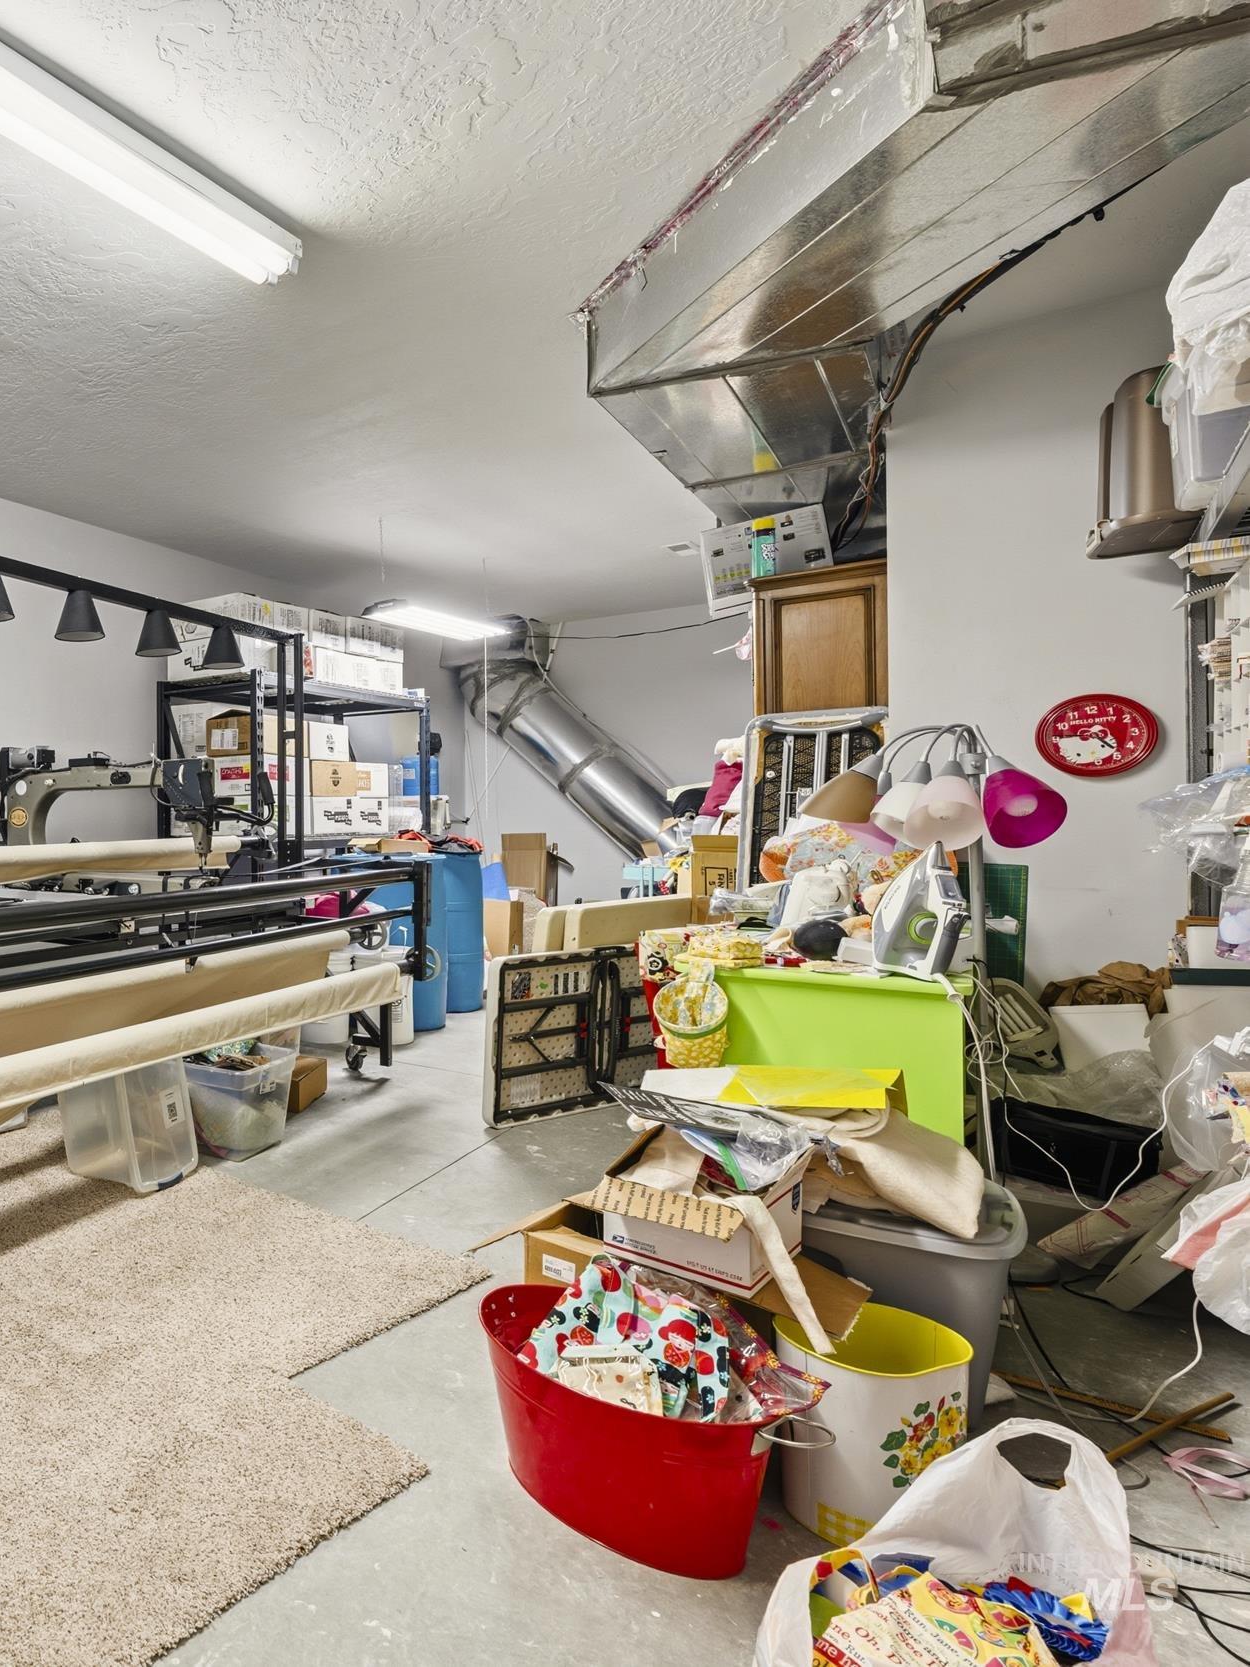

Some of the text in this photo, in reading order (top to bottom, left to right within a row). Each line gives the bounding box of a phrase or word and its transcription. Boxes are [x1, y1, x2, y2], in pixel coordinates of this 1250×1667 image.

[1085, 705, 1098, 715] 12
[1107, 706, 1114, 715] 1
[1068, 711, 1079, 720] 11
[1122, 714, 1131, 723] 2
[1069, 715, 1117, 726] HELLO KITTY
[1056, 722, 1069, 730] 10
[1131, 727, 1139, 736] 3
[1126, 741, 1135, 749] 4
